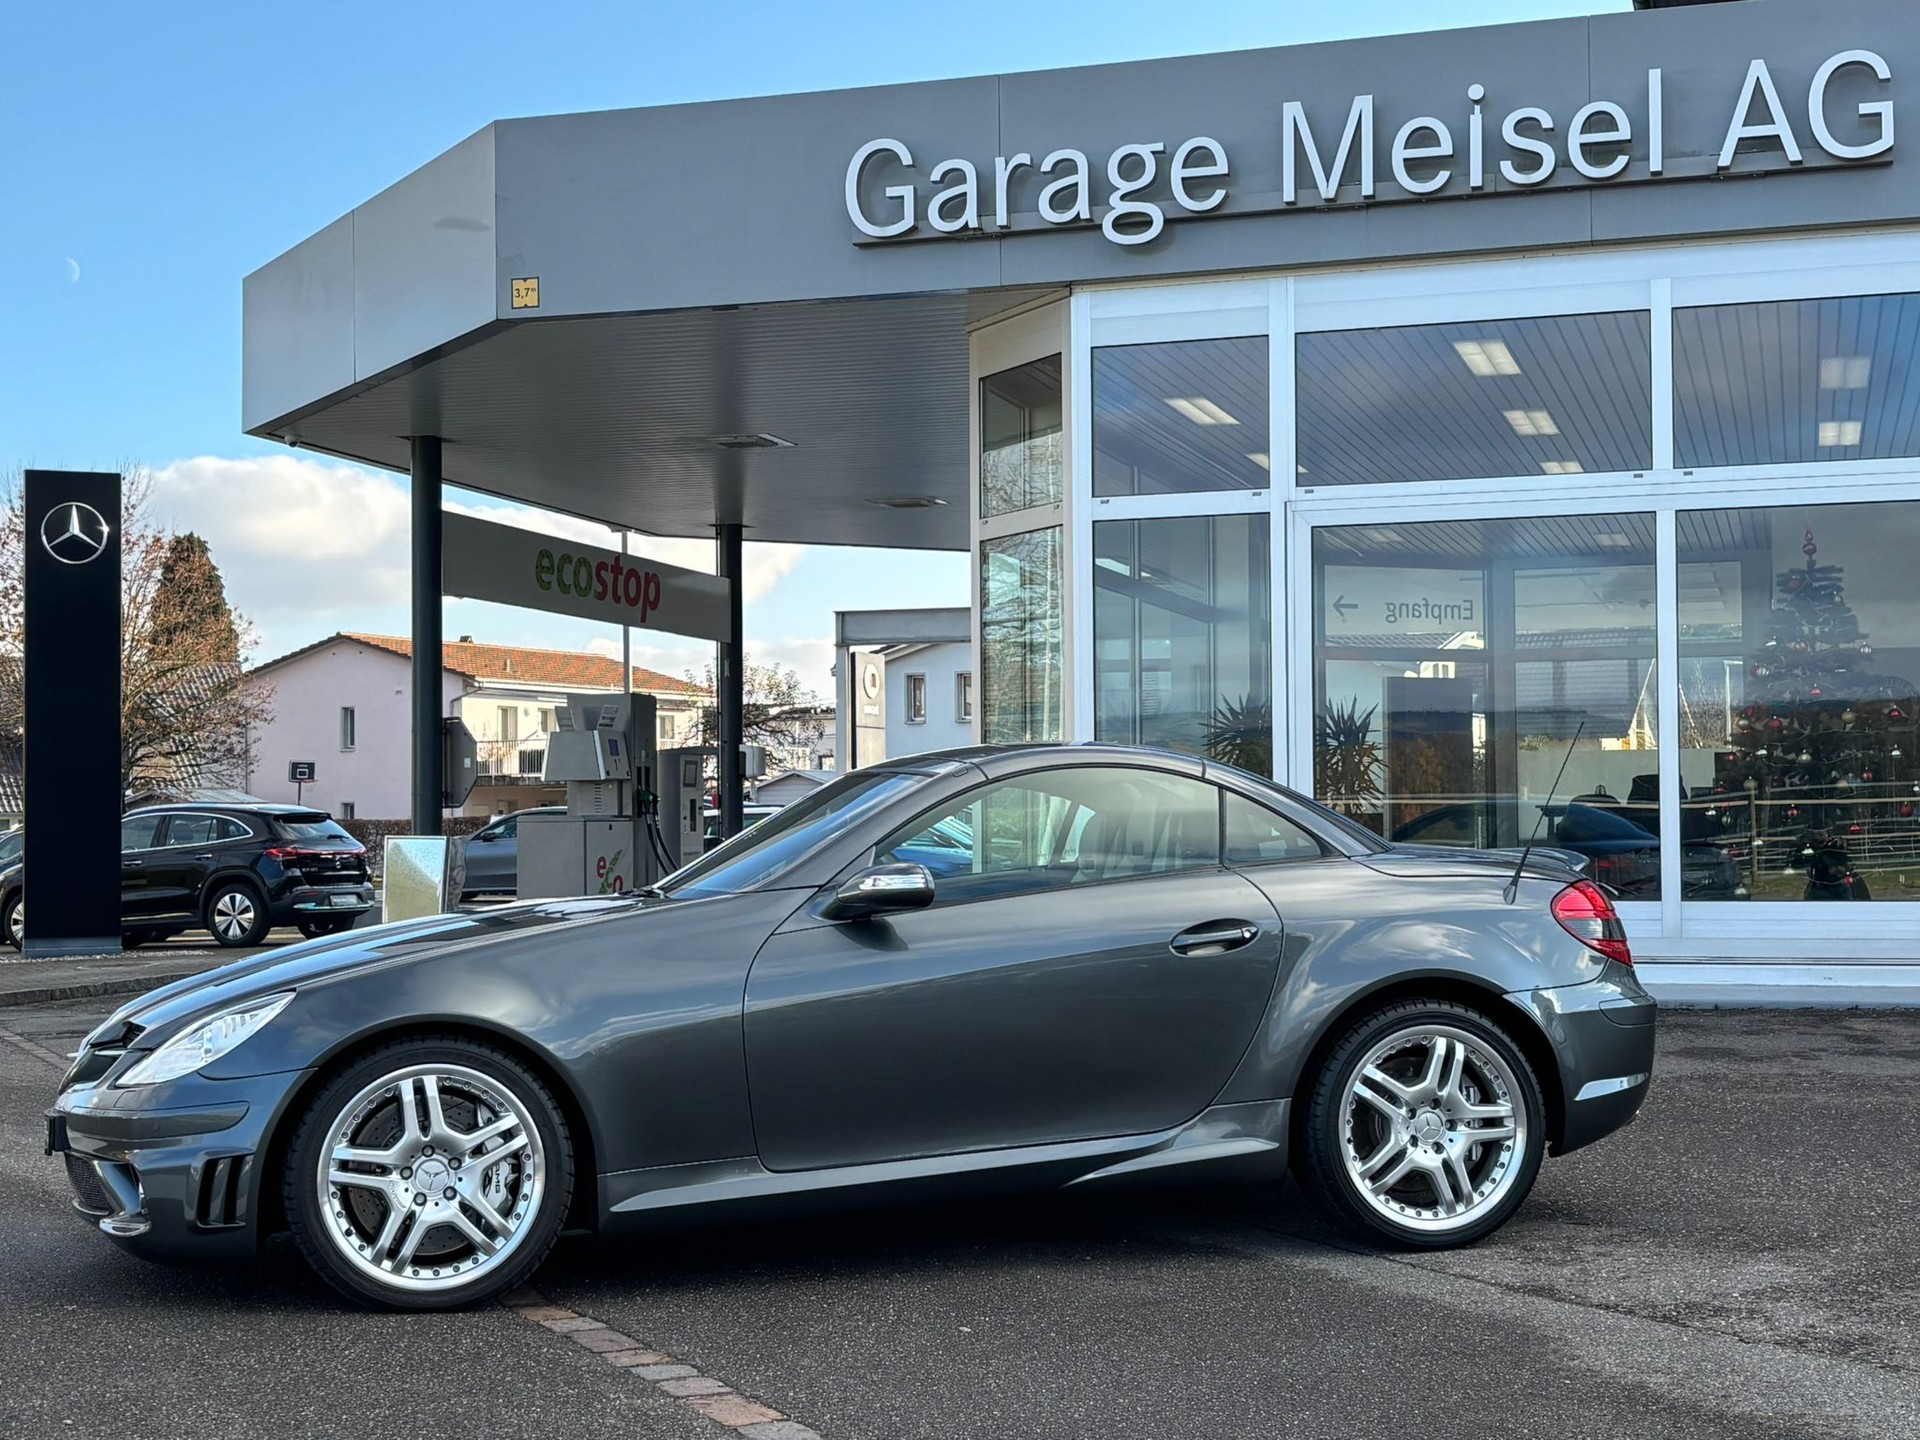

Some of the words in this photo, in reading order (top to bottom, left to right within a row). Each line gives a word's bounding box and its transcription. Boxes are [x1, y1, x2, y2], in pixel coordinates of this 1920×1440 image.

[845, 136, 1229, 246] Garage
[1283, 67, 1663, 204] Meisel
[1717, 49, 1895, 170] AG
[535, 548, 661, 623] ecostop
